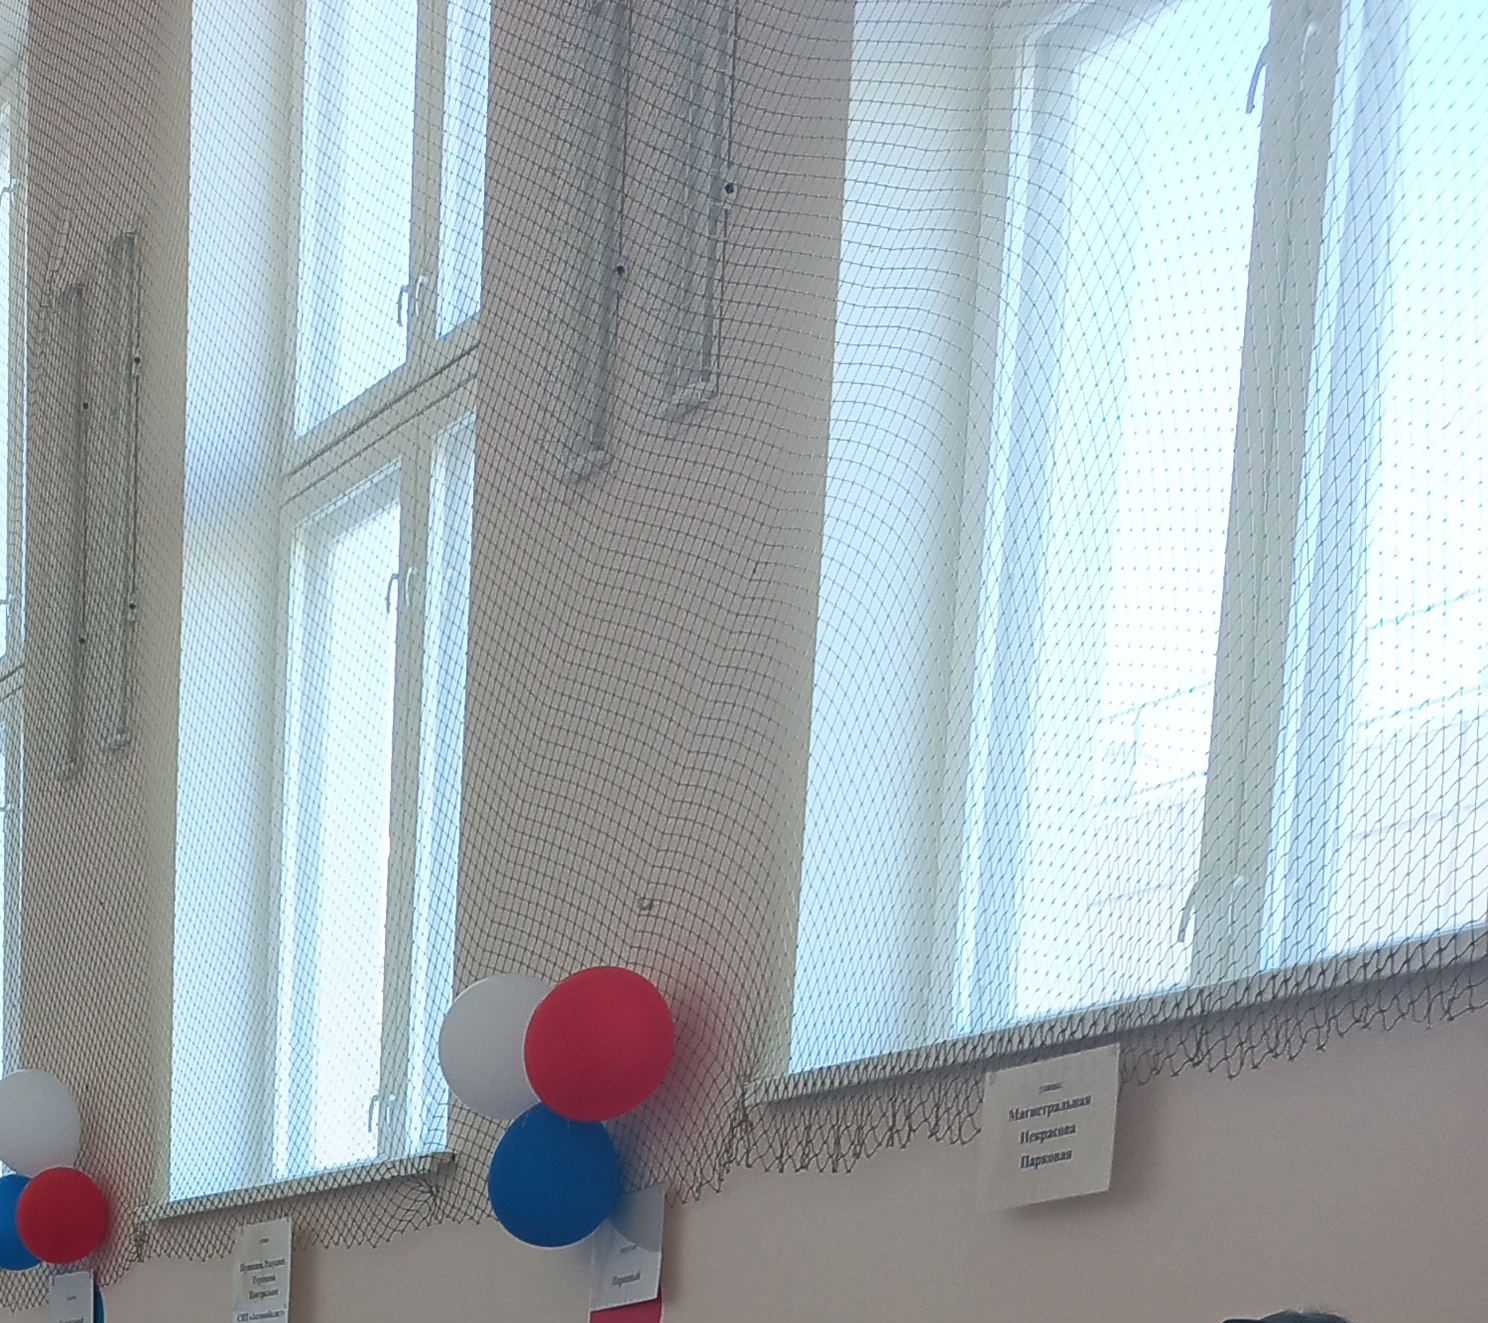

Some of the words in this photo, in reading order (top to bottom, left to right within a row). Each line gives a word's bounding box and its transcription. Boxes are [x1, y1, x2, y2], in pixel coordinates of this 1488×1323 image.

[1009, 1095, 1092, 1122] Магистральная
[1019, 1124, 1076, 1145] Некрасова
[1019, 1149, 1073, 1170] Парковая
